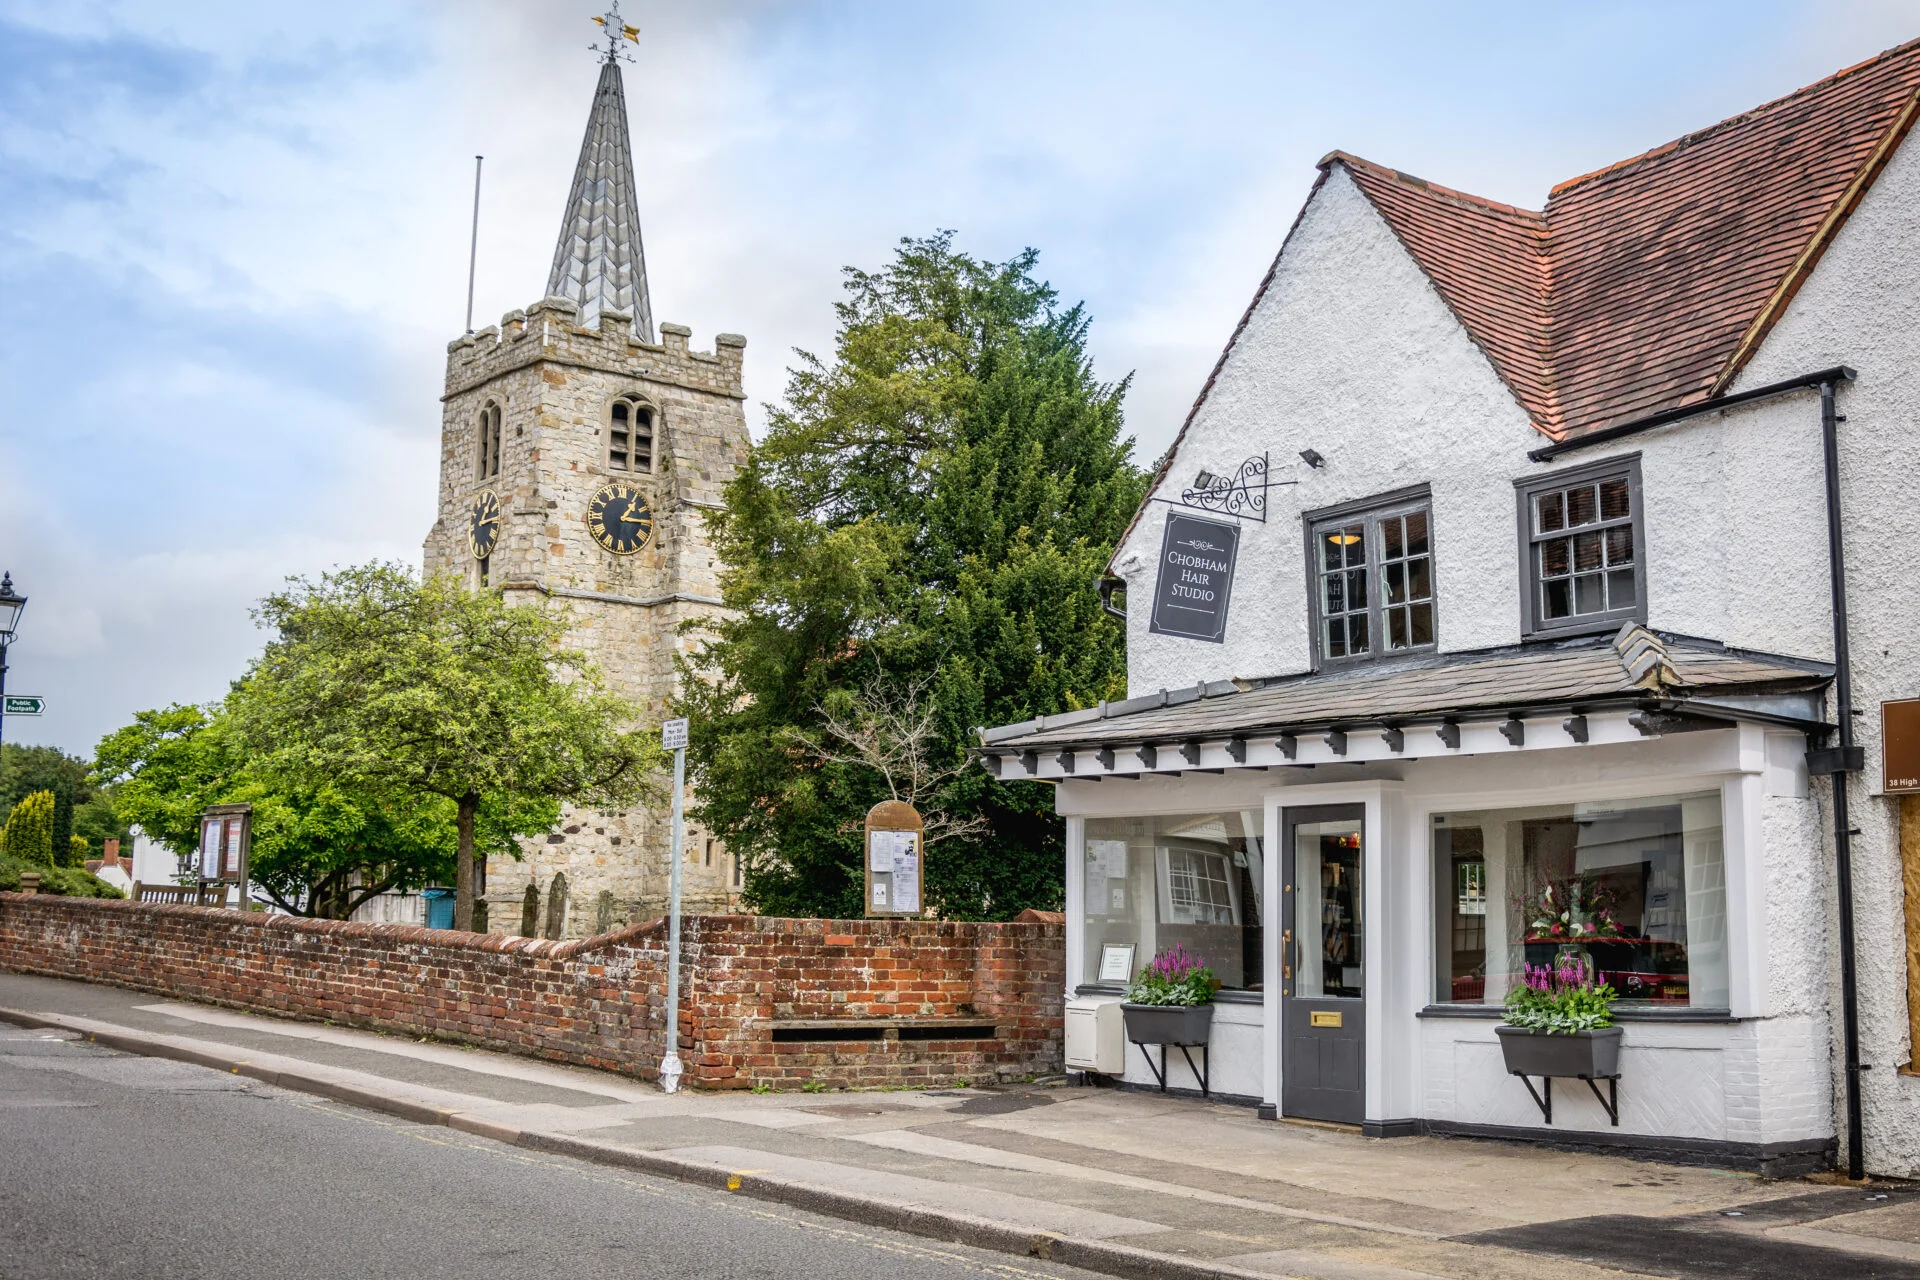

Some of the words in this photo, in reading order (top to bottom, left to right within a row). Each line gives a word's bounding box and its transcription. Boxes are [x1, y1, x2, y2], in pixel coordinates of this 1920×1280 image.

[1168, 551, 1227, 572] CHOBHAM
[1181, 569, 1209, 585] HAIR
[1171, 583, 1214, 601] STUDIO
[1900, 778, 1918, 786] High
